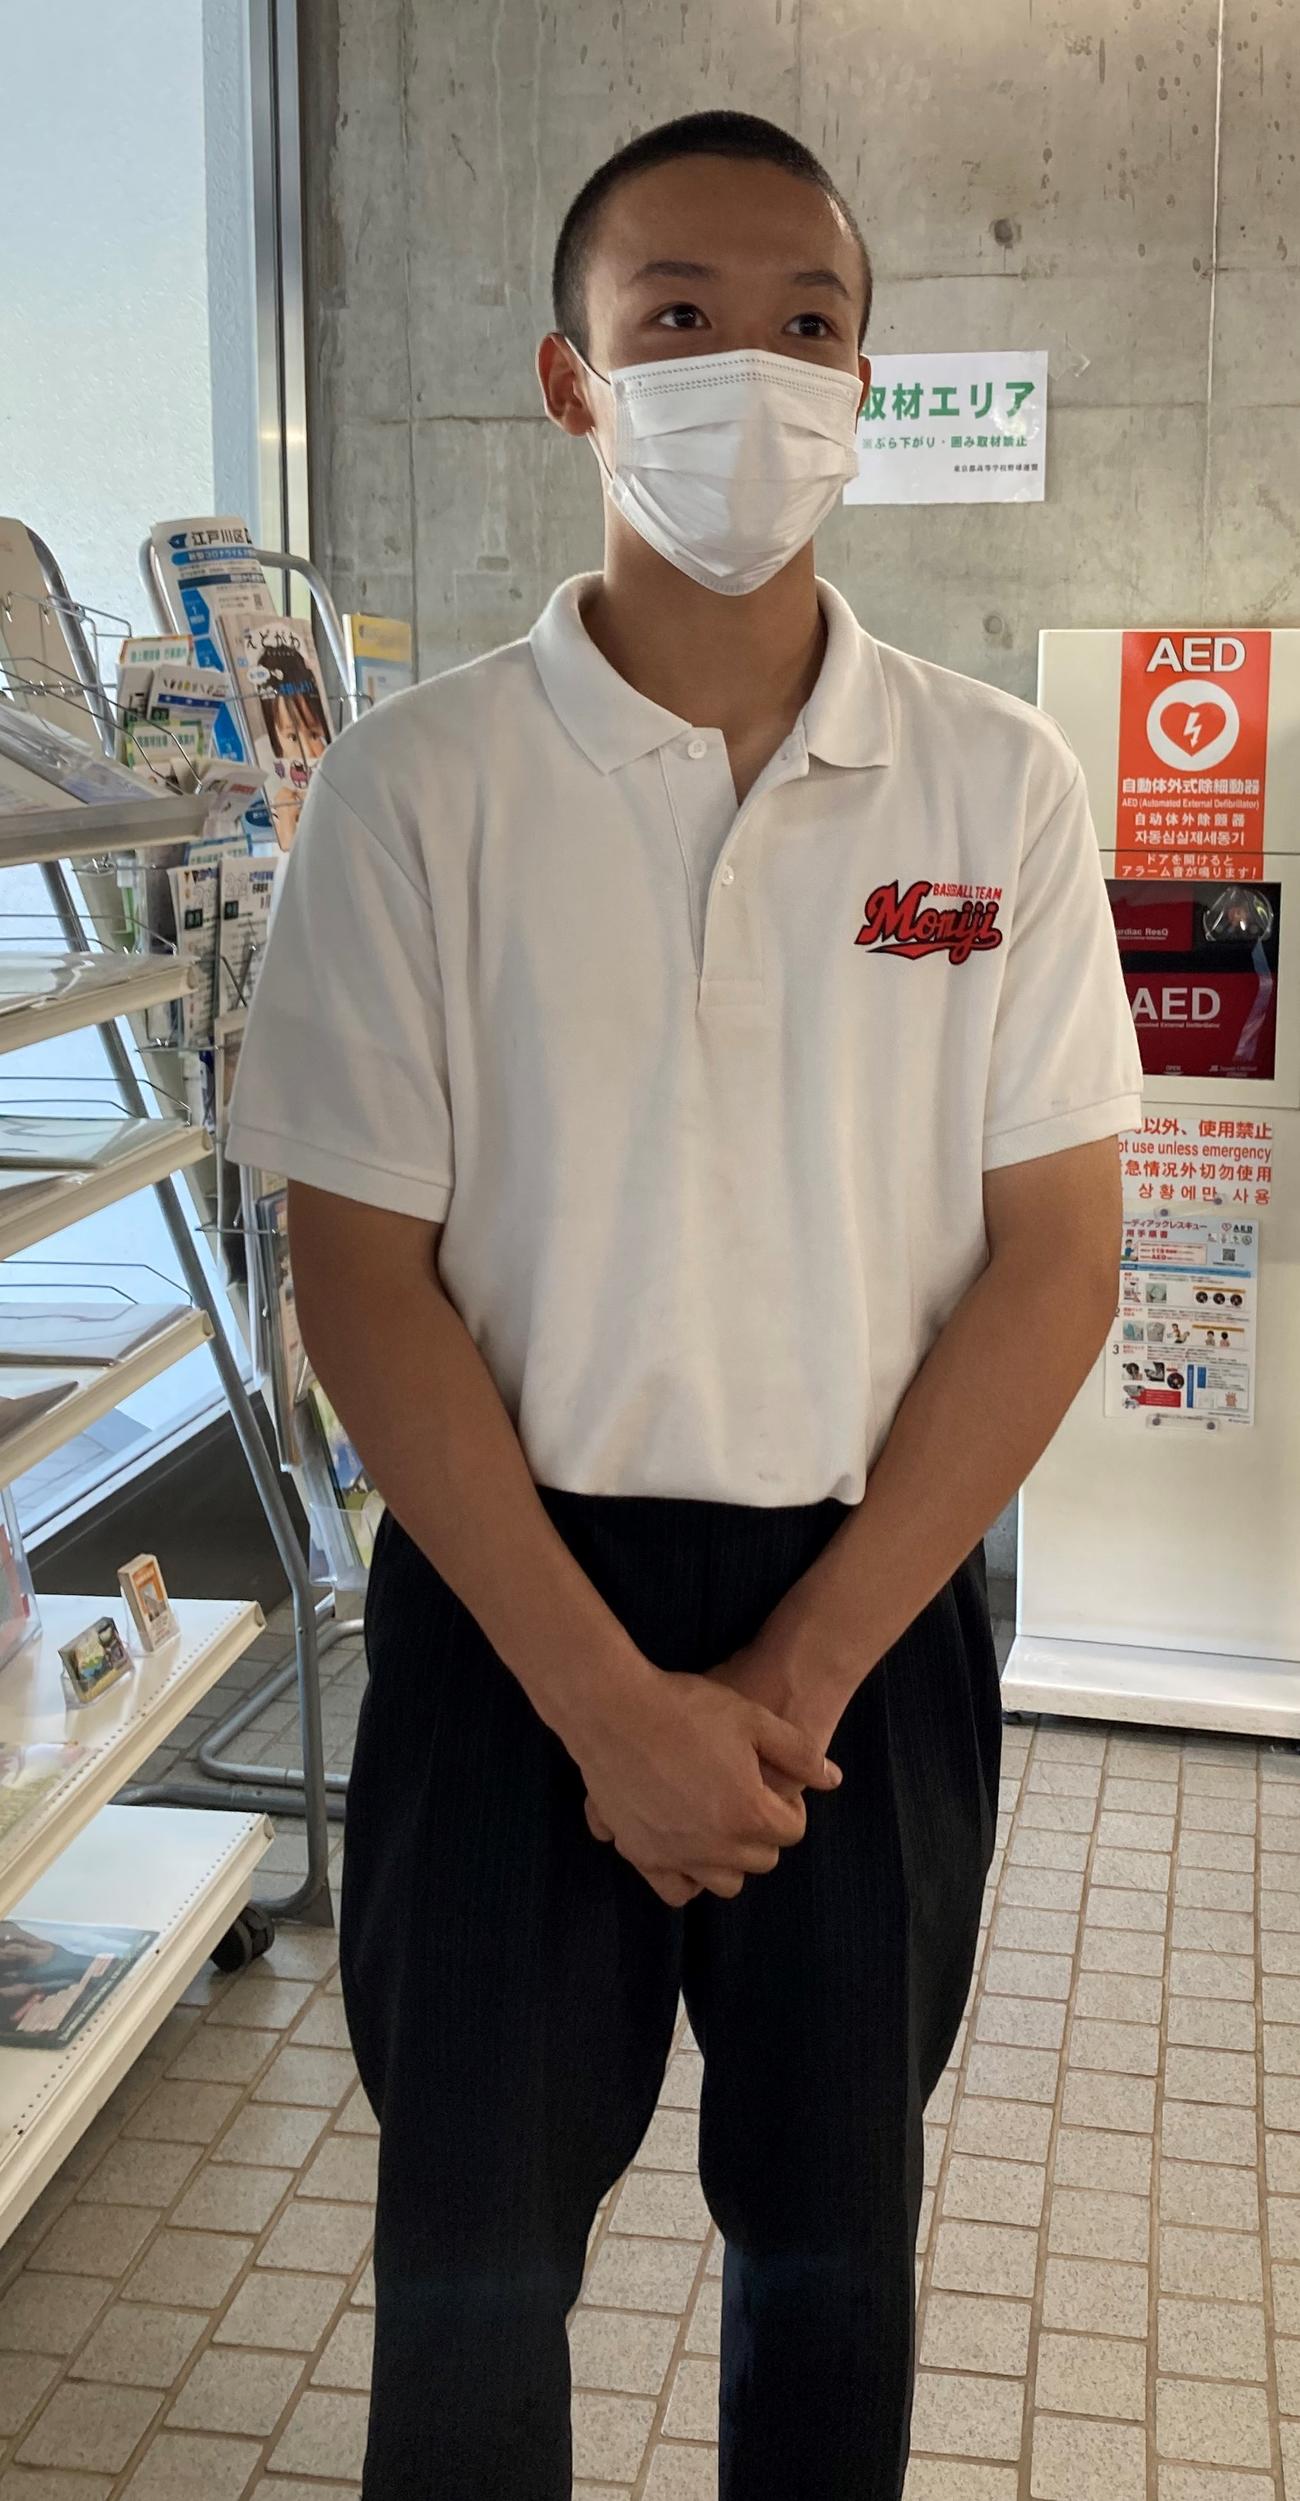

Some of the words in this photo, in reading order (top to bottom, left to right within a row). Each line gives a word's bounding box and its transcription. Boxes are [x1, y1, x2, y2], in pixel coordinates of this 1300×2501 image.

[859, 382, 1035, 421] 取材エリア
[1146, 637, 1246, 673] AED
[1122, 777, 1260, 795] 自動体外式除細動器
[1122, 798, 1139, 808] AED
[1139, 799, 1181, 809] (Automated
[1183, 799, 1213, 808] External
[1214, 799, 1260, 810] Defibrillator)
[1147, 853, 1234, 866] ドアを開けると
[975, 886, 1003, 901] TEAM
[1115, 927, 1142, 936] ardiac
[1130, 987, 1221, 1021] AED
[1134, 1117, 1273, 1140] 以外、使用禁止
[1119, 1139, 1128, 1153] ot
[1132, 1142, 1155, 1154] use
[1158, 1140, 1198, 1156] unless
[1202, 1145, 1271, 1163] emergency
[1121, 1159, 1272, 1183] 急情况外切勿使用
[1233, 1187, 1270, 1205] 사용
[1124, 1219, 1207, 1231] ーディアックレスキュー
[1112, 1344, 1119, 1355] 3
